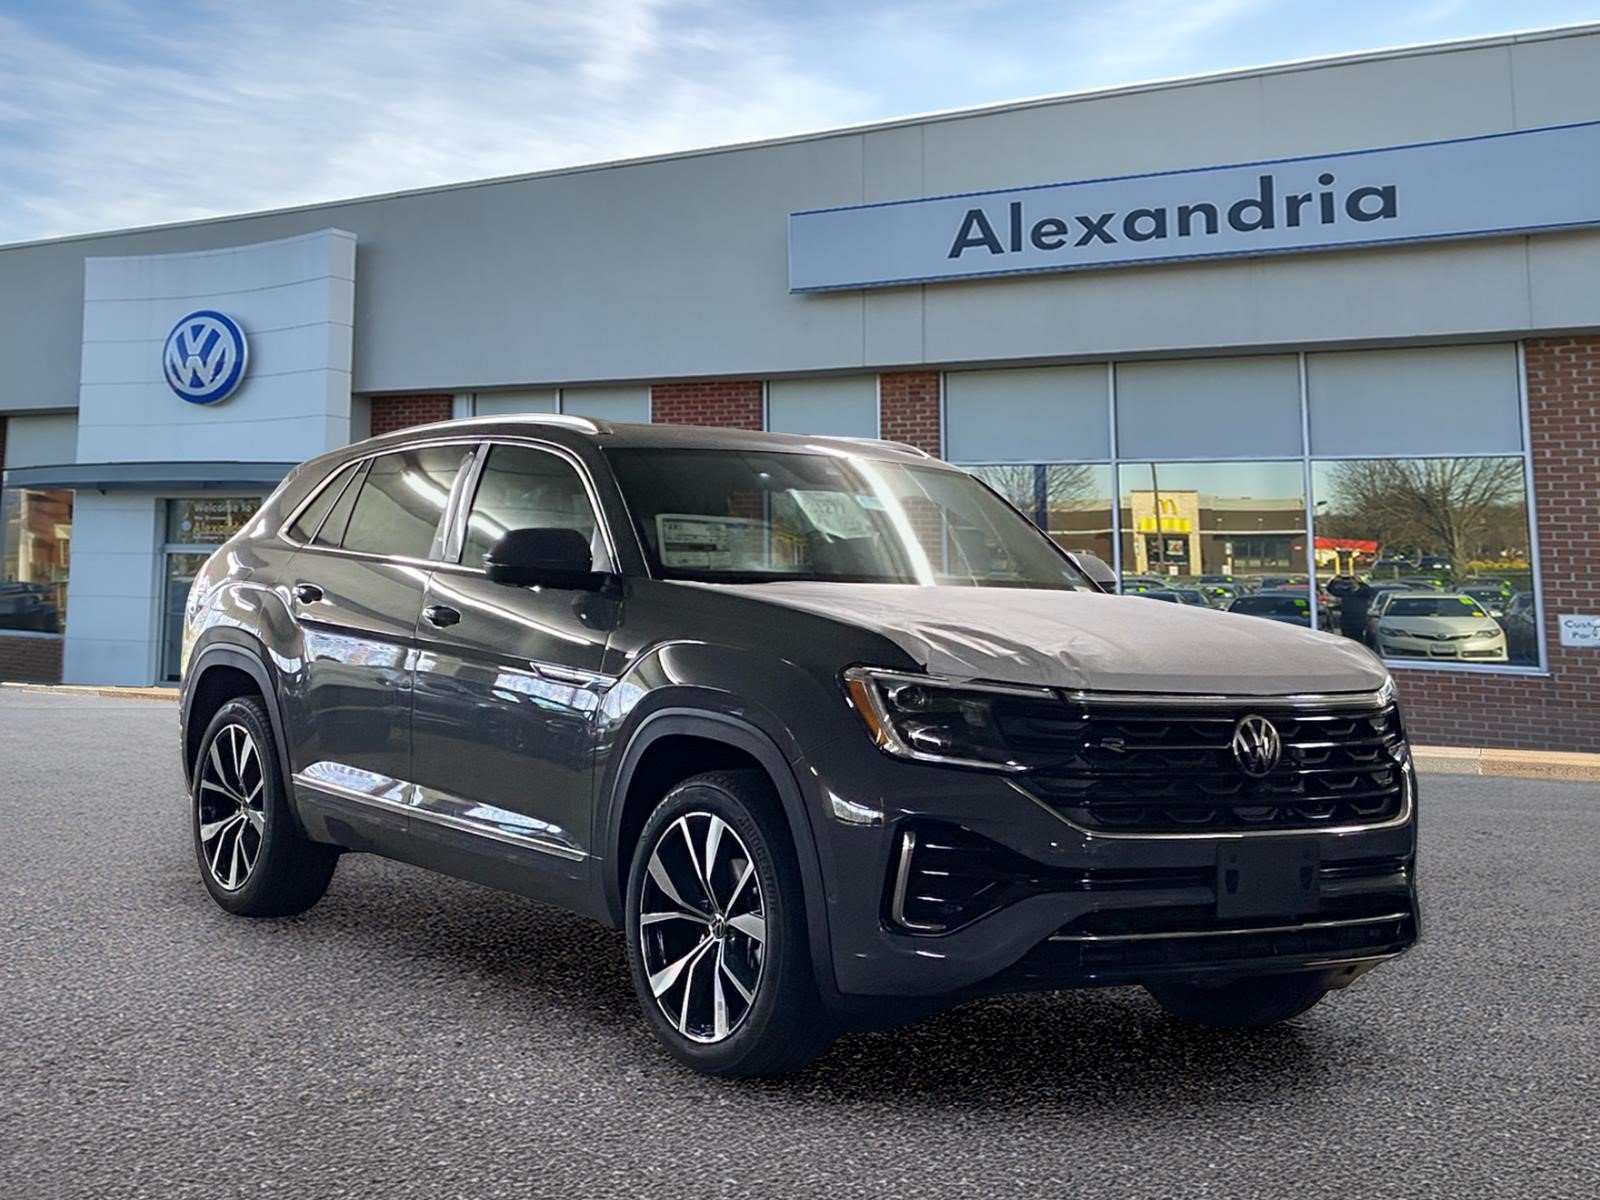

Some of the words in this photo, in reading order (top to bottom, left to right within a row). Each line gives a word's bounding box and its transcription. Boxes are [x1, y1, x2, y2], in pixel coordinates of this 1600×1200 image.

[947, 172, 1398, 259] Alexandria
[166, 314, 242, 400] VW
[194, 503, 239, 512] Welcome
[1233, 715, 1280, 777] VW
